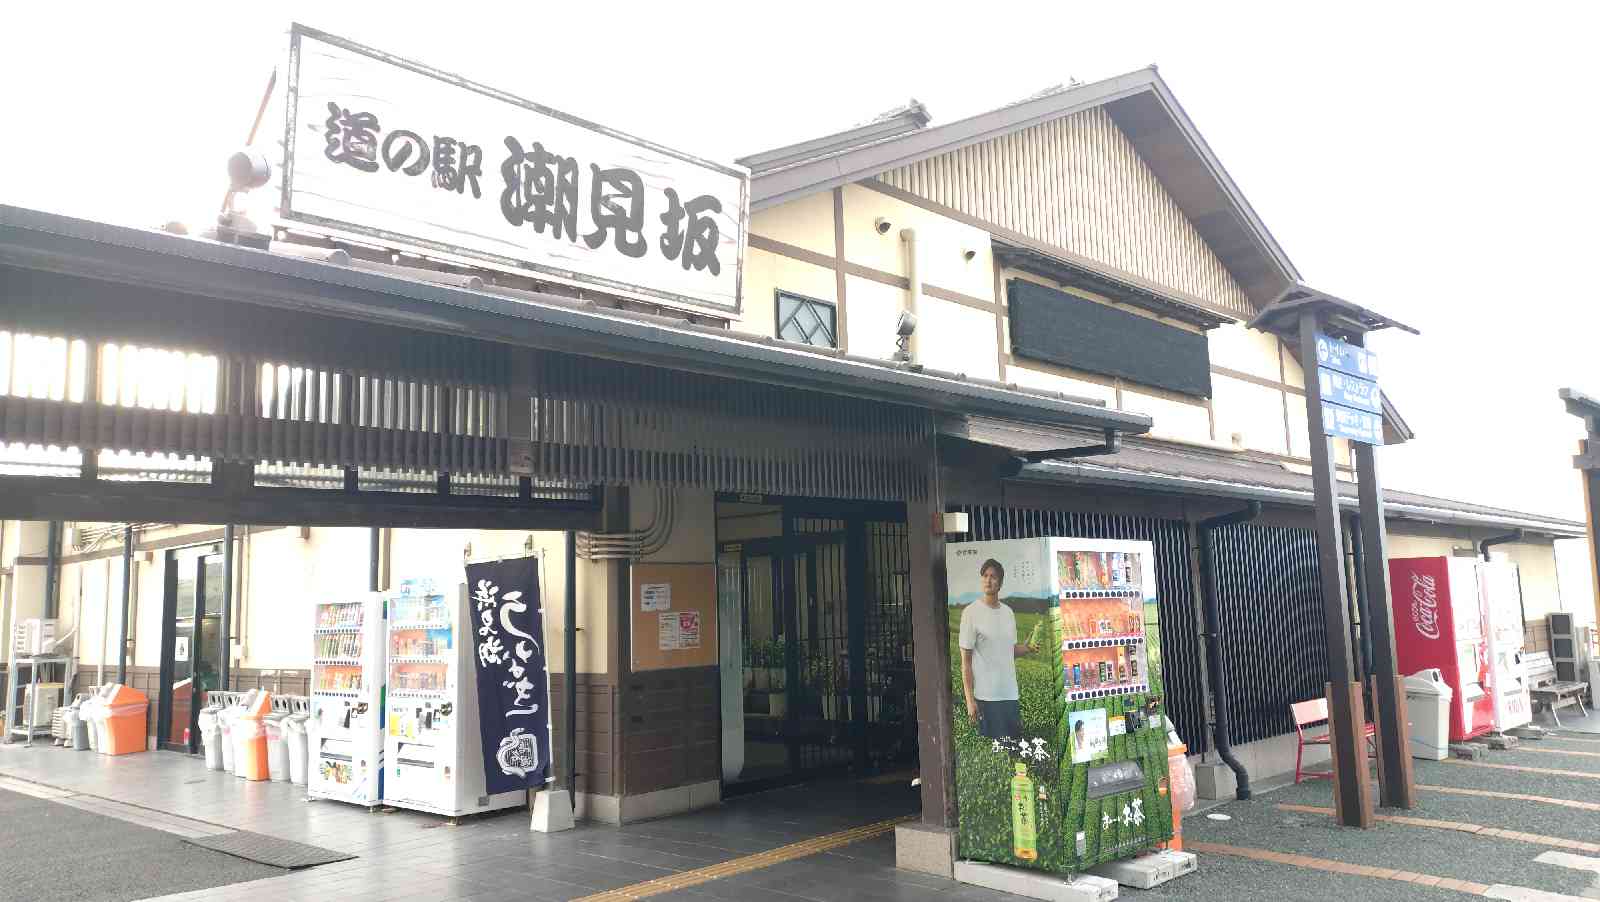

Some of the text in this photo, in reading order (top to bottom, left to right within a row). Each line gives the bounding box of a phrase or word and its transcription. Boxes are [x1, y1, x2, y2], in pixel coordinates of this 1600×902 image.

[324, 102, 723, 276] 道の駅 潮見坂
[1412, 571, 1440, 640] Coca-Cola
